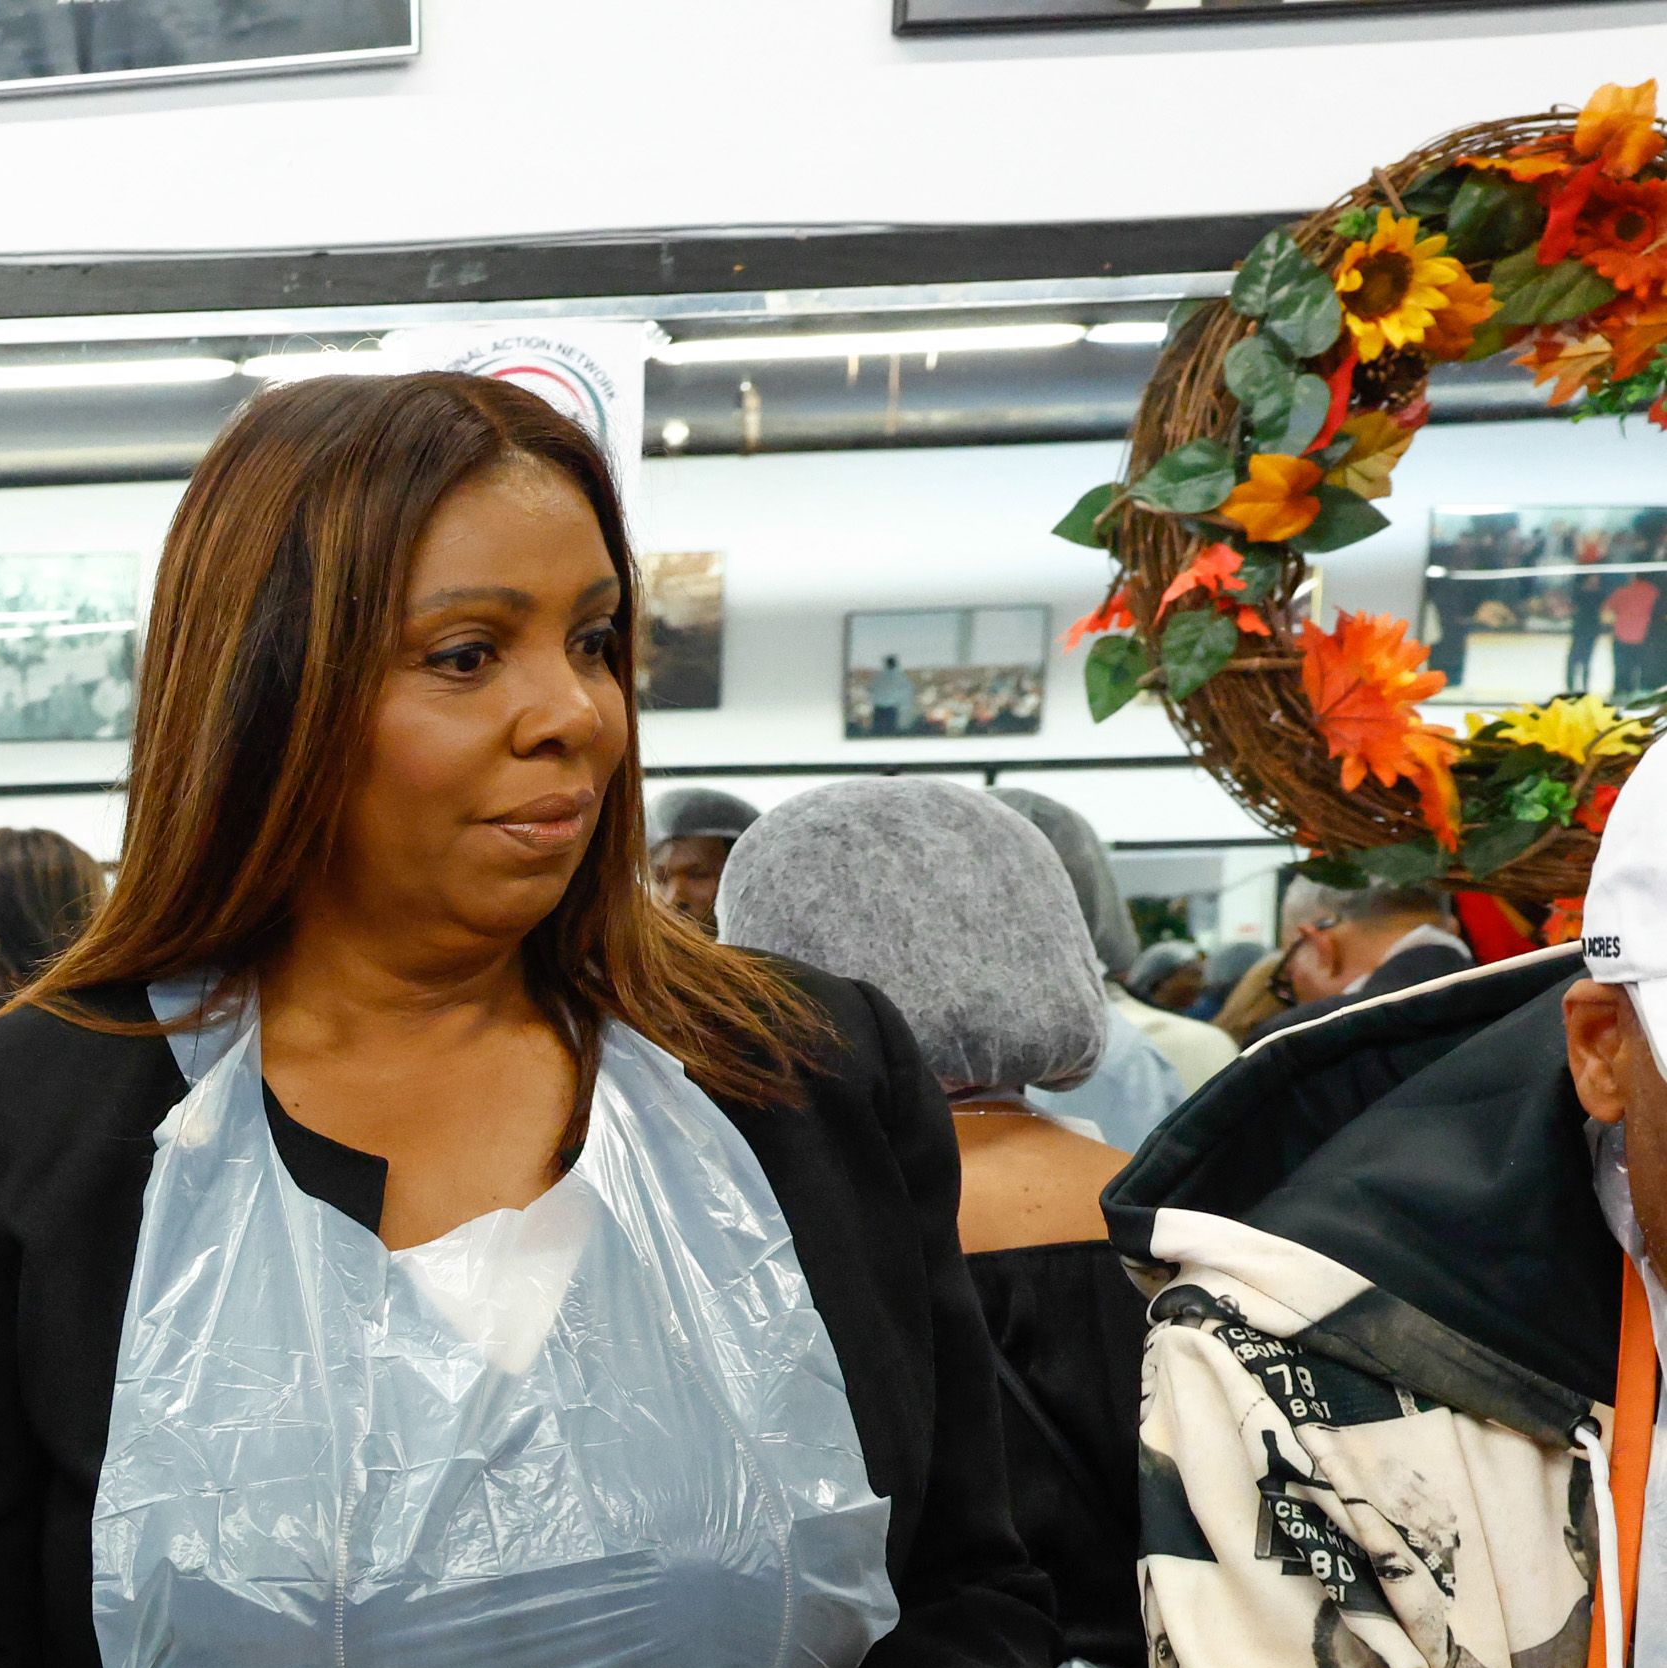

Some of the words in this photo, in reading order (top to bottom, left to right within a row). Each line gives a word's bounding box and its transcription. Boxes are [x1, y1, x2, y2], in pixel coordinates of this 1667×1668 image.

[491, 336, 552, 353] ACTION
[555, 343, 619, 402] NETWORK
[1265, 1363, 1316, 1398] 78
[1310, 1549, 1357, 1583] 80
